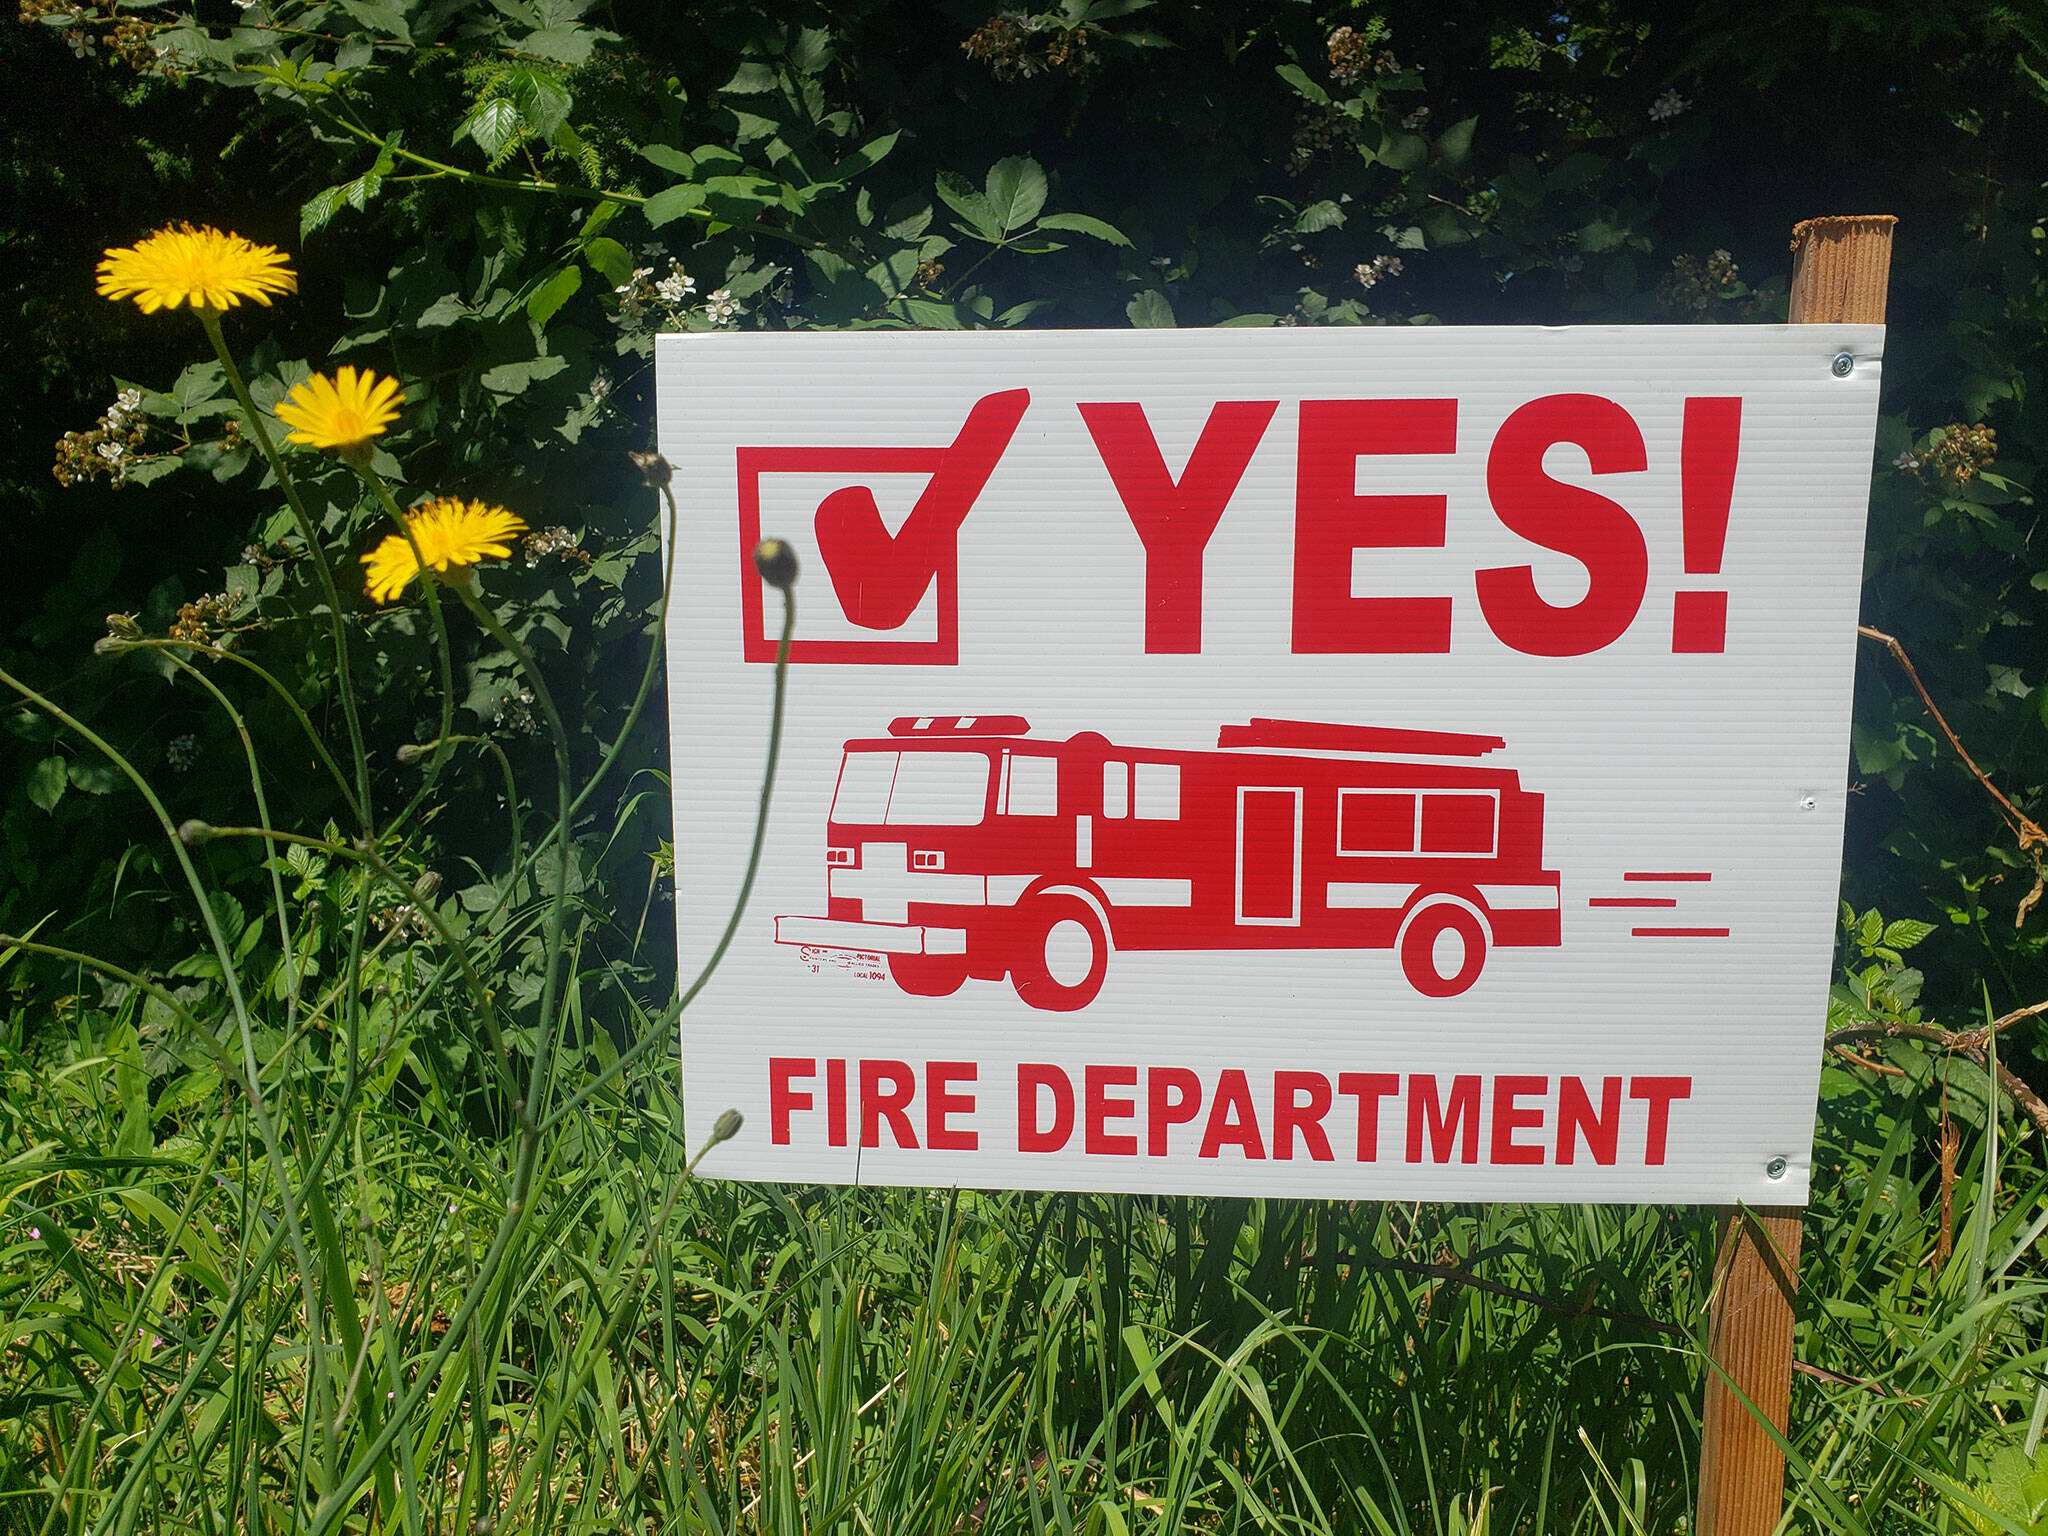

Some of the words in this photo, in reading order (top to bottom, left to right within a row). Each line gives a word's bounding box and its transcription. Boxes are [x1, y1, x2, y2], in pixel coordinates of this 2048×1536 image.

[1078, 392, 1743, 658] YES!
[868, 971, 886, 982] 1094
[769, 1057, 979, 1151] FIRE
[1017, 1063, 1693, 1166] DEPARTMENT
